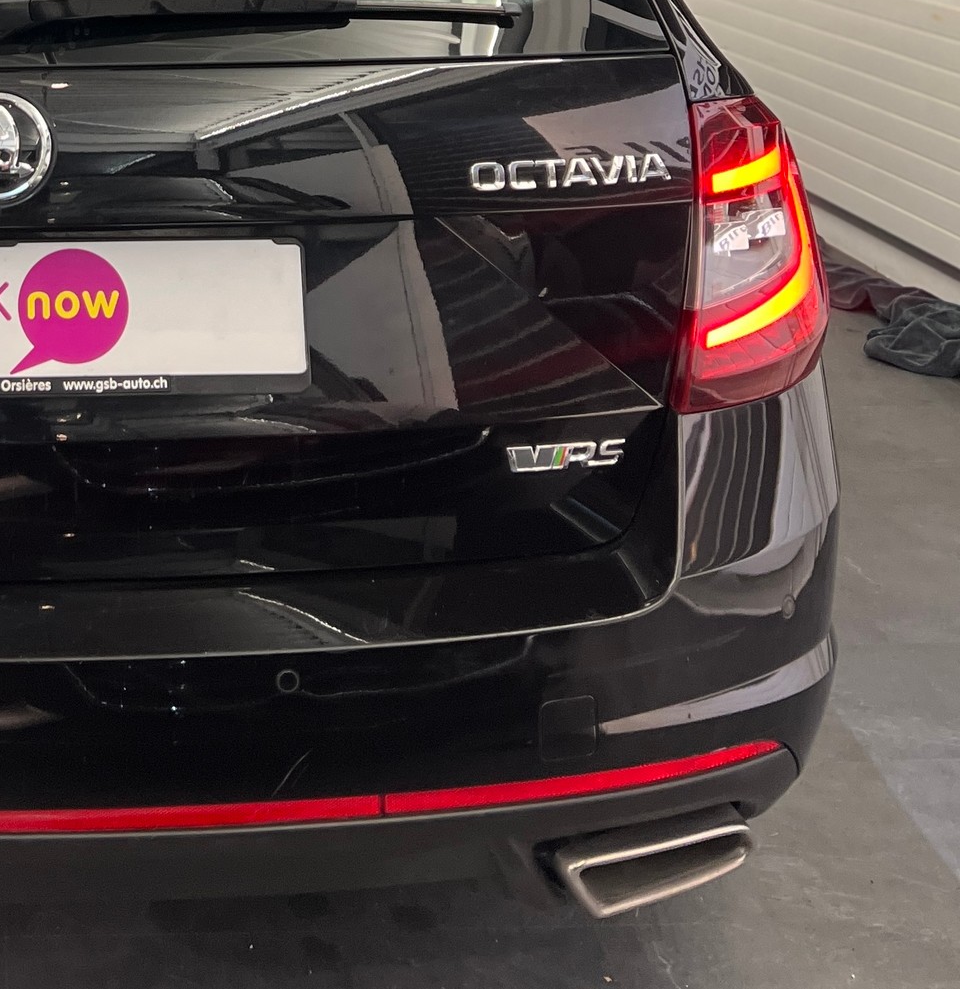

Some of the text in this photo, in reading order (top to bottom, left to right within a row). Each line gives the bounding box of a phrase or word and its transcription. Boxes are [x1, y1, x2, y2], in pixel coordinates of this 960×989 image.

[469, 153, 673, 192] OCTAVIA
[27, 290, 120, 320] now
[0, 377, 52, 392] Orsières
[63, 375, 168, 394] www.gsb-auto.ch
